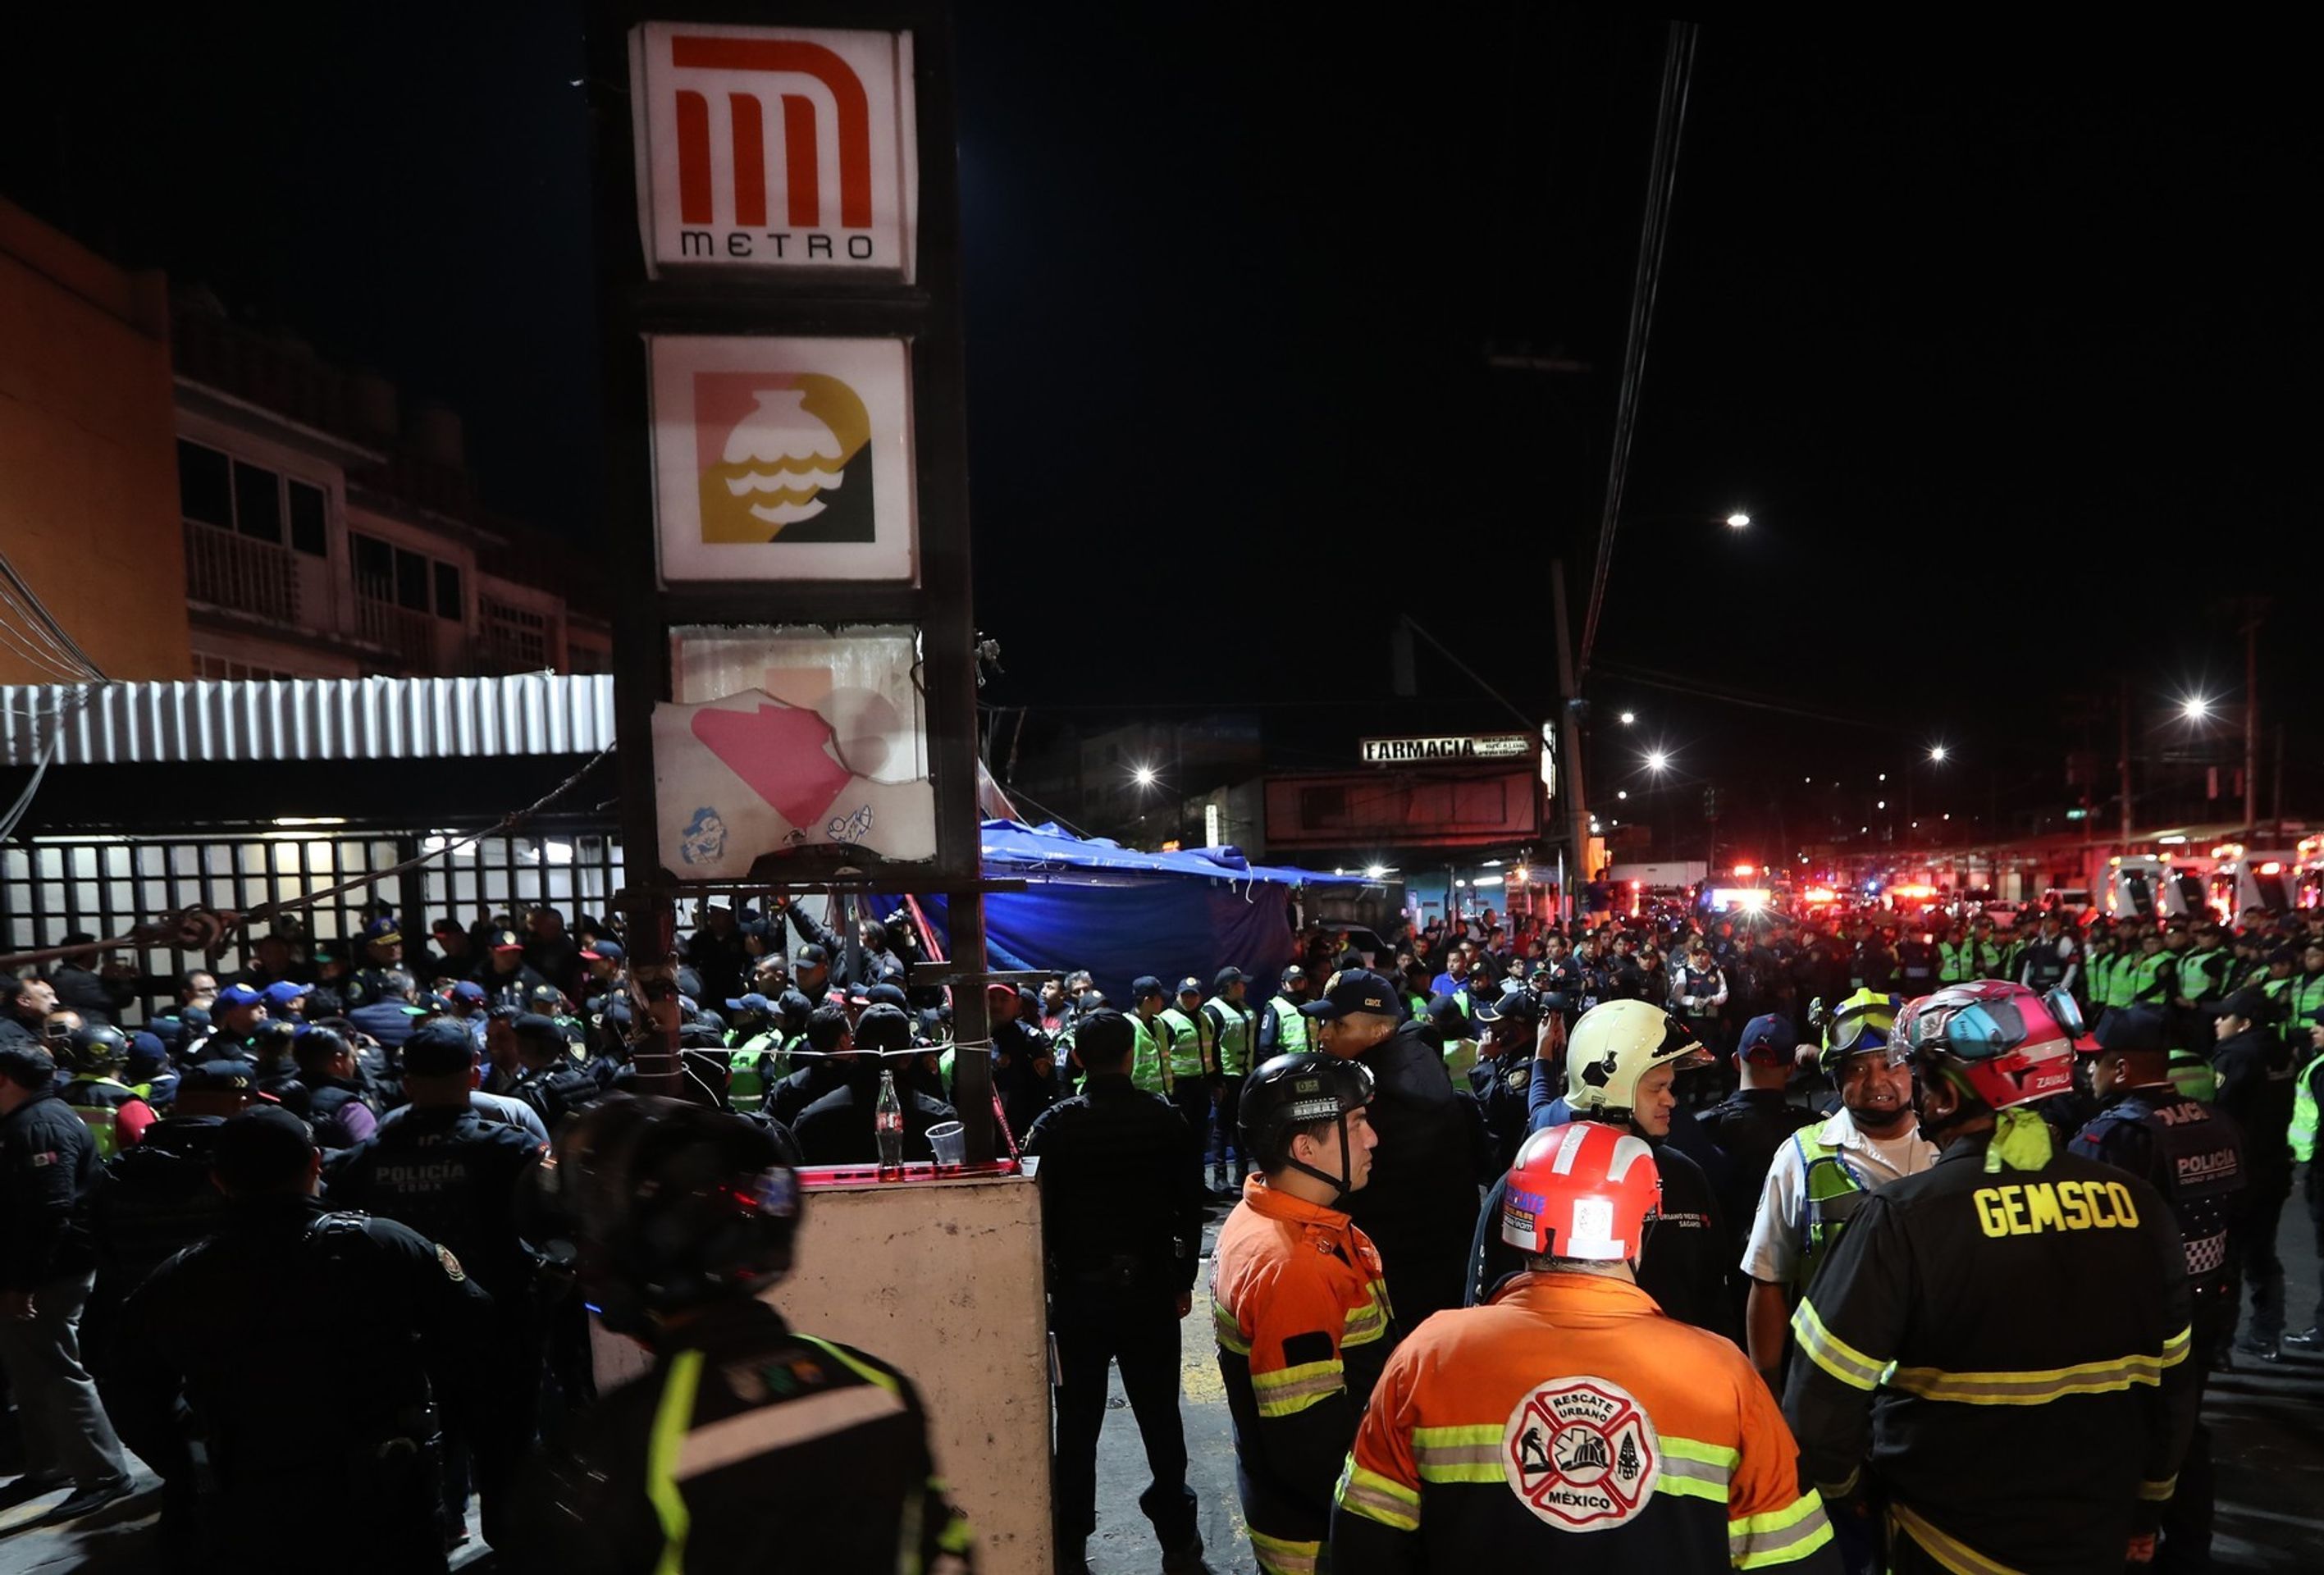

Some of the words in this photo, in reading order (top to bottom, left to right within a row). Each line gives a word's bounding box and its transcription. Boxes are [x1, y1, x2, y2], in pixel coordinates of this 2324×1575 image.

[682, 231, 873, 259] METRO
[1365, 738, 1475, 760] FARMACIA
[374, 1160, 466, 1182] POLICÍA
[1973, 1180, 2139, 1238] GEMSCO
[1553, 1394, 1614, 1413] RESCATE
[1559, 1407, 1608, 1423] URBANO
[1548, 1491, 1611, 1509] MÉXICO
